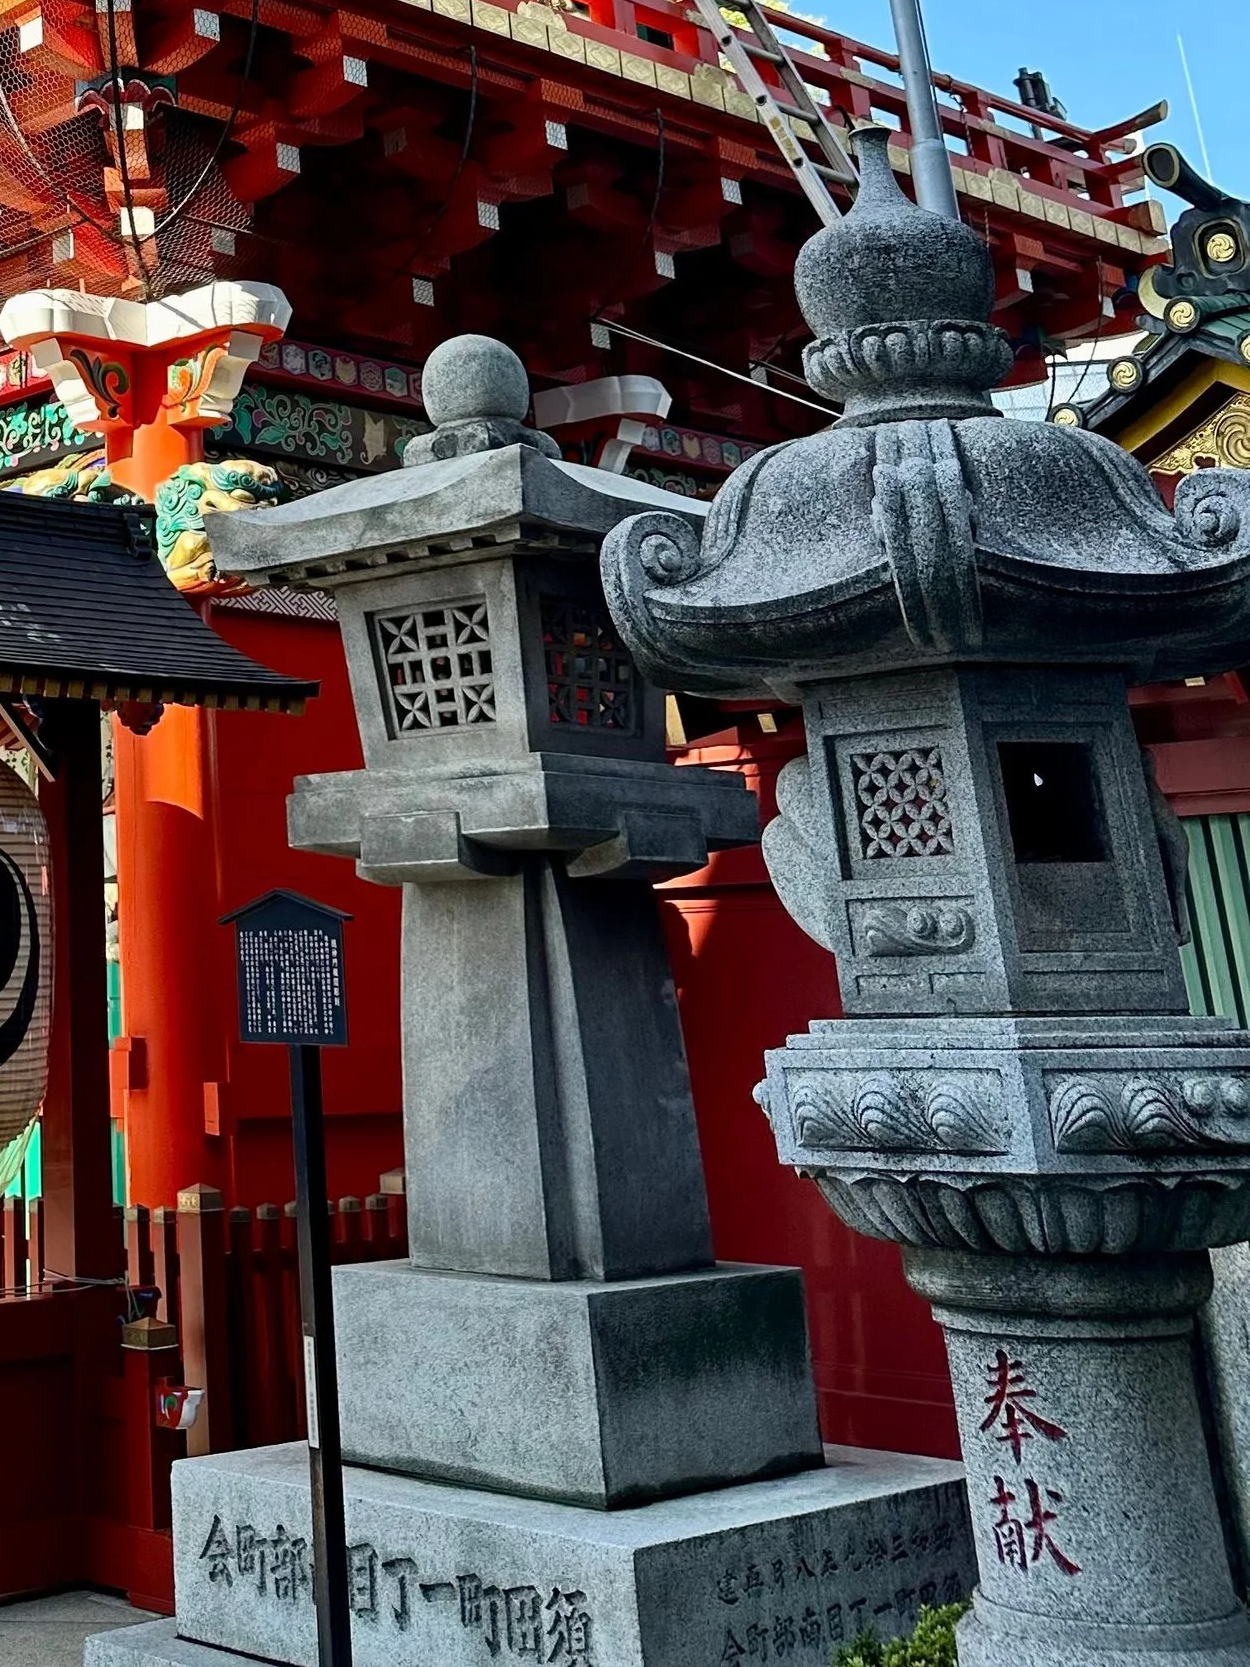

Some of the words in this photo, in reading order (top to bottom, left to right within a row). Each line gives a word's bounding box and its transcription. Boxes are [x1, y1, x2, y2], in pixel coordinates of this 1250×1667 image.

[980, 1349, 1082, 1575] 奉献
[199, 1514, 594, 1667] 須田町一丁目部町会
